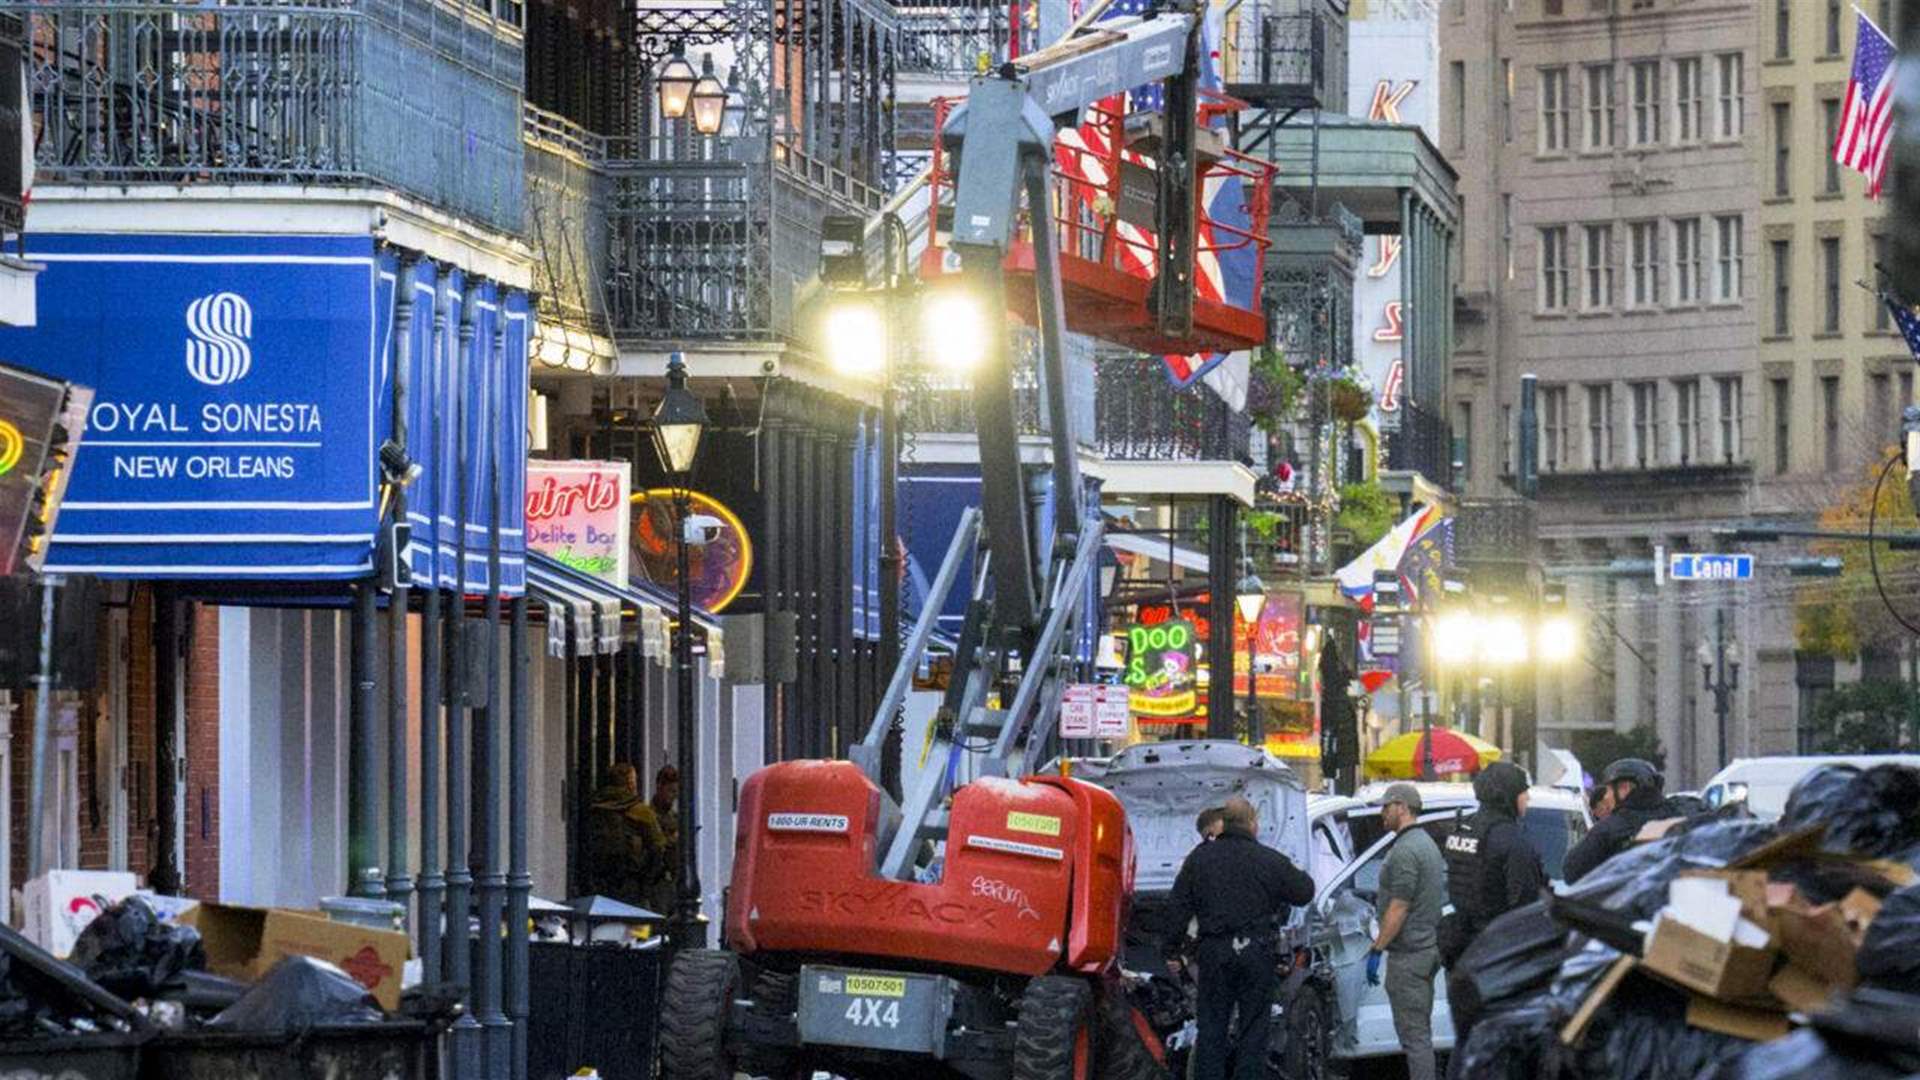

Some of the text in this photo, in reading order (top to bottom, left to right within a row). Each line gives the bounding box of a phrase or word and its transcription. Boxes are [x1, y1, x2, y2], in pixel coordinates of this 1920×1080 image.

[84, 403, 321, 432] OYAL SONESTA
[114, 456, 294, 478] NEW ORLEANS
[1691, 557, 1738, 578] Canal
[847, 978, 903, 992] 10507501
[845, 998, 900, 1028] 4X4
